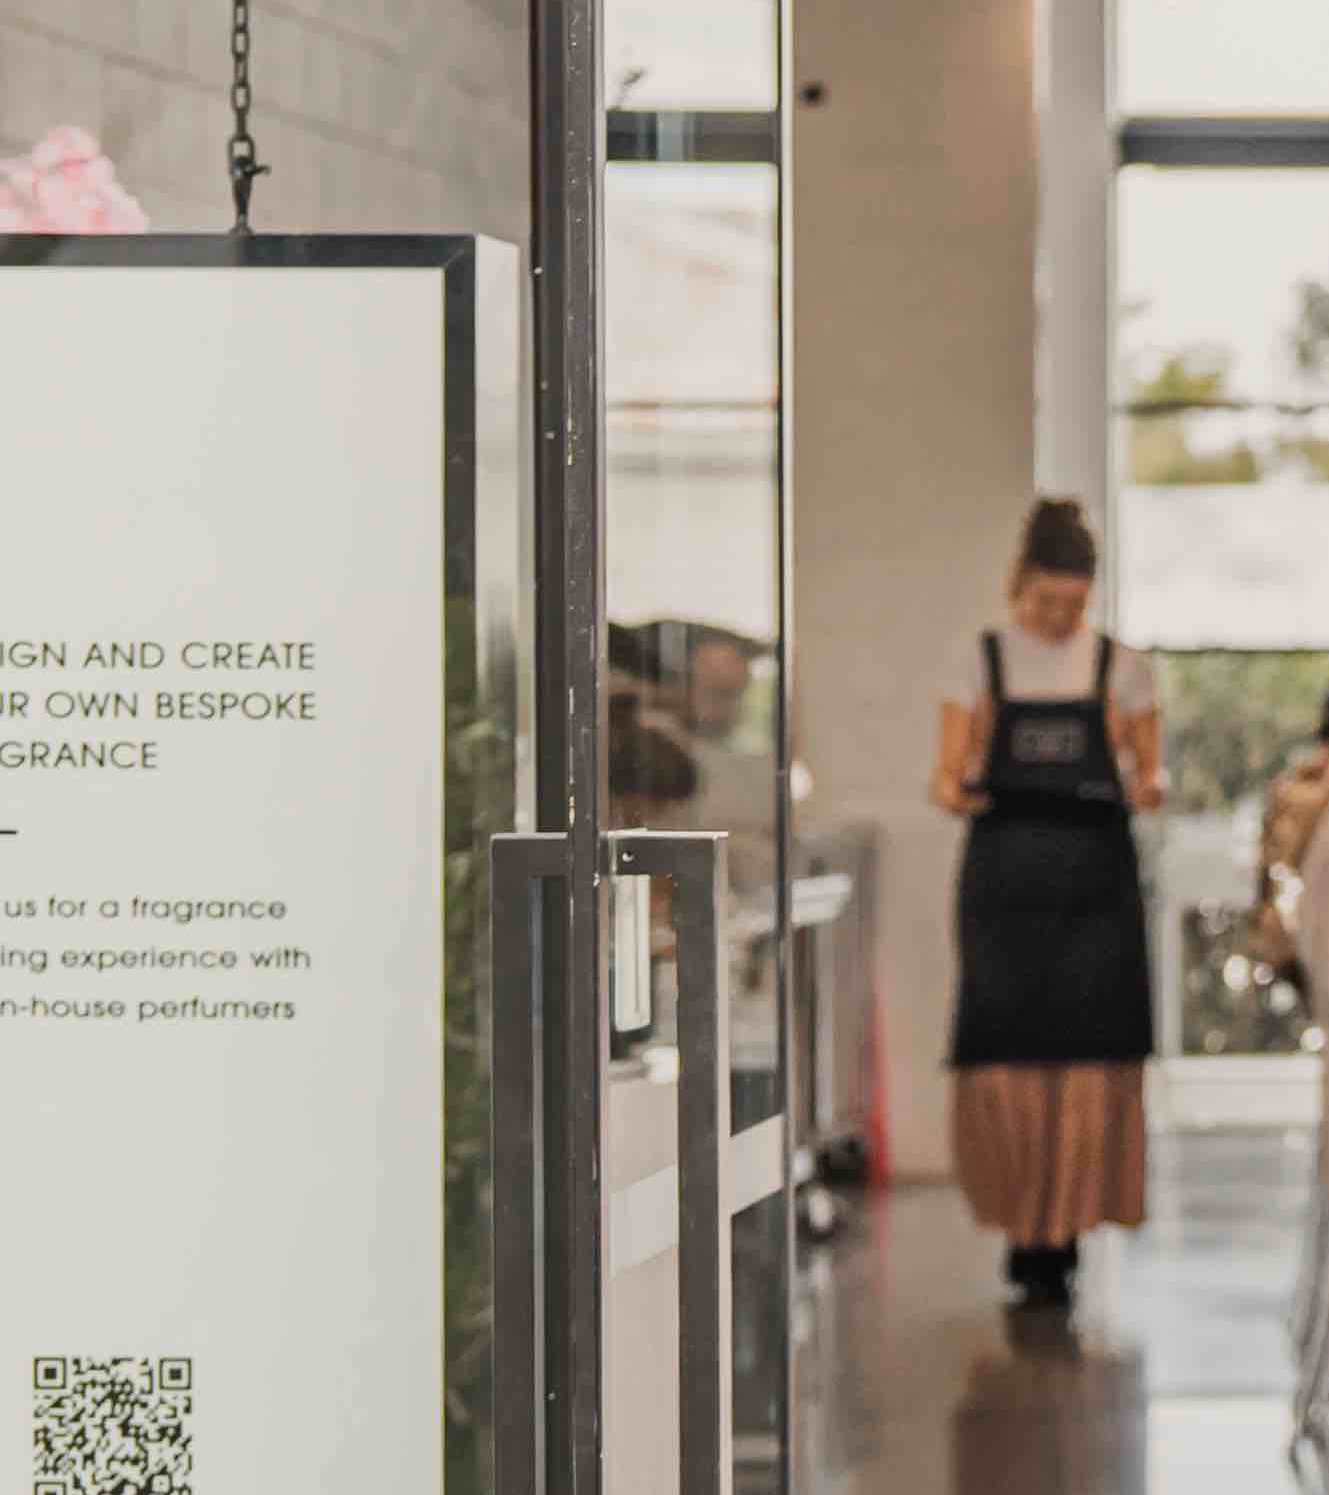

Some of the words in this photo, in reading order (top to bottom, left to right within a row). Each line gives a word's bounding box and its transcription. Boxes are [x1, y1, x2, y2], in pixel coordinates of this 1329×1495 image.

[82, 641, 165, 670] AND
[180, 641, 316, 671] CREATE
[44, 690, 139, 719] OWN
[155, 691, 316, 721] BESPOKE
[0, 740, 158, 769] GRANCE
[4, 899, 37, 919] us
[48, 894, 88, 919] for
[98, 899, 120, 919] a
[131, 895, 288, 925] fragrance
[60, 945, 238, 974] experience
[250, 945, 312, 970] with
[137, 995, 296, 1023] perfumers
